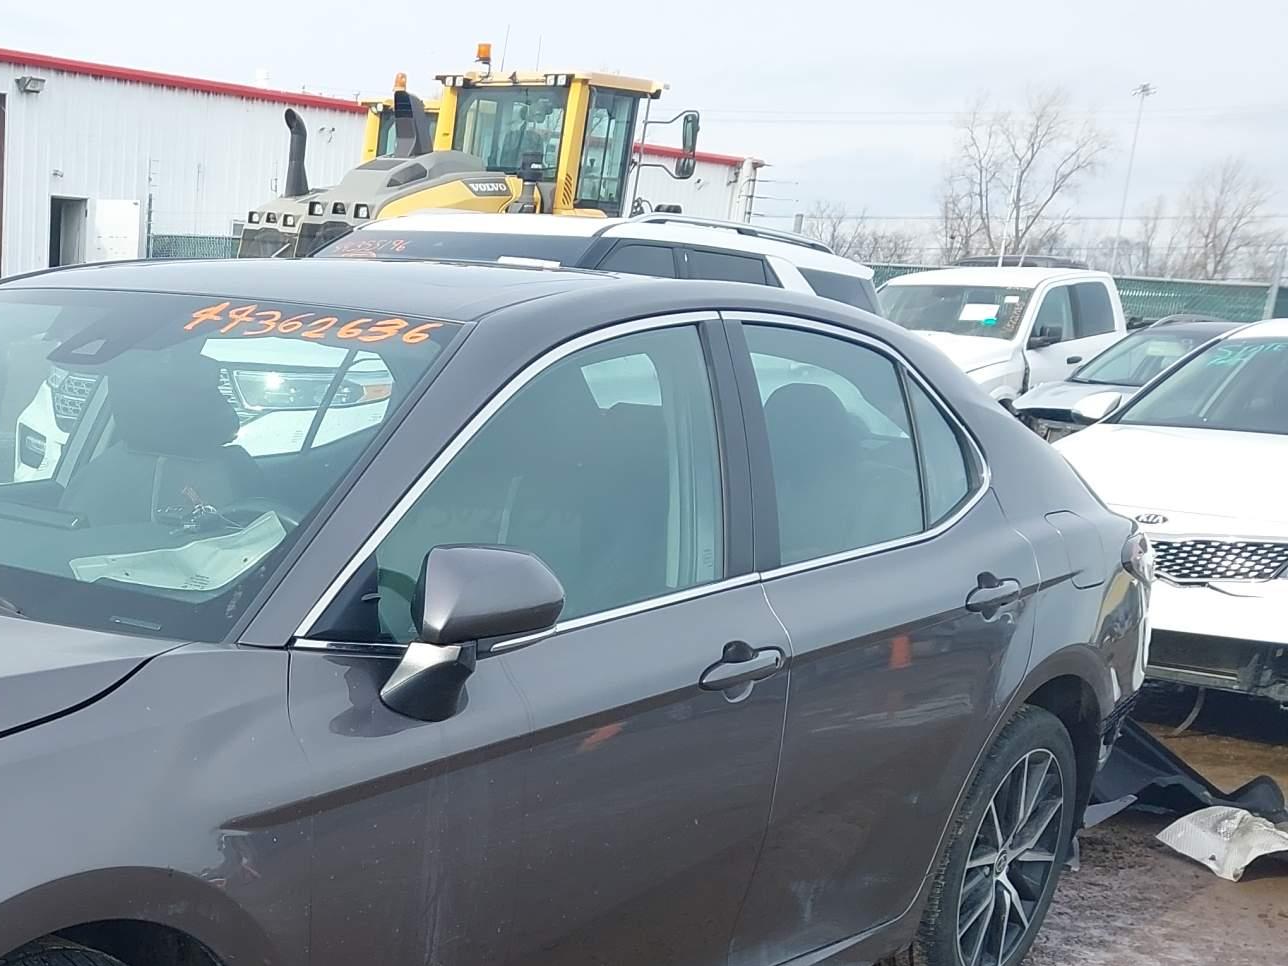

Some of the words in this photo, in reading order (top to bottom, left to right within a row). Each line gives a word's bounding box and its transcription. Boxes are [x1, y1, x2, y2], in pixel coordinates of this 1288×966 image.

[469, 182, 507, 192] VOLVO
[183, 301, 443, 344] 44362636
[1137, 513, 1164, 524] KIA
